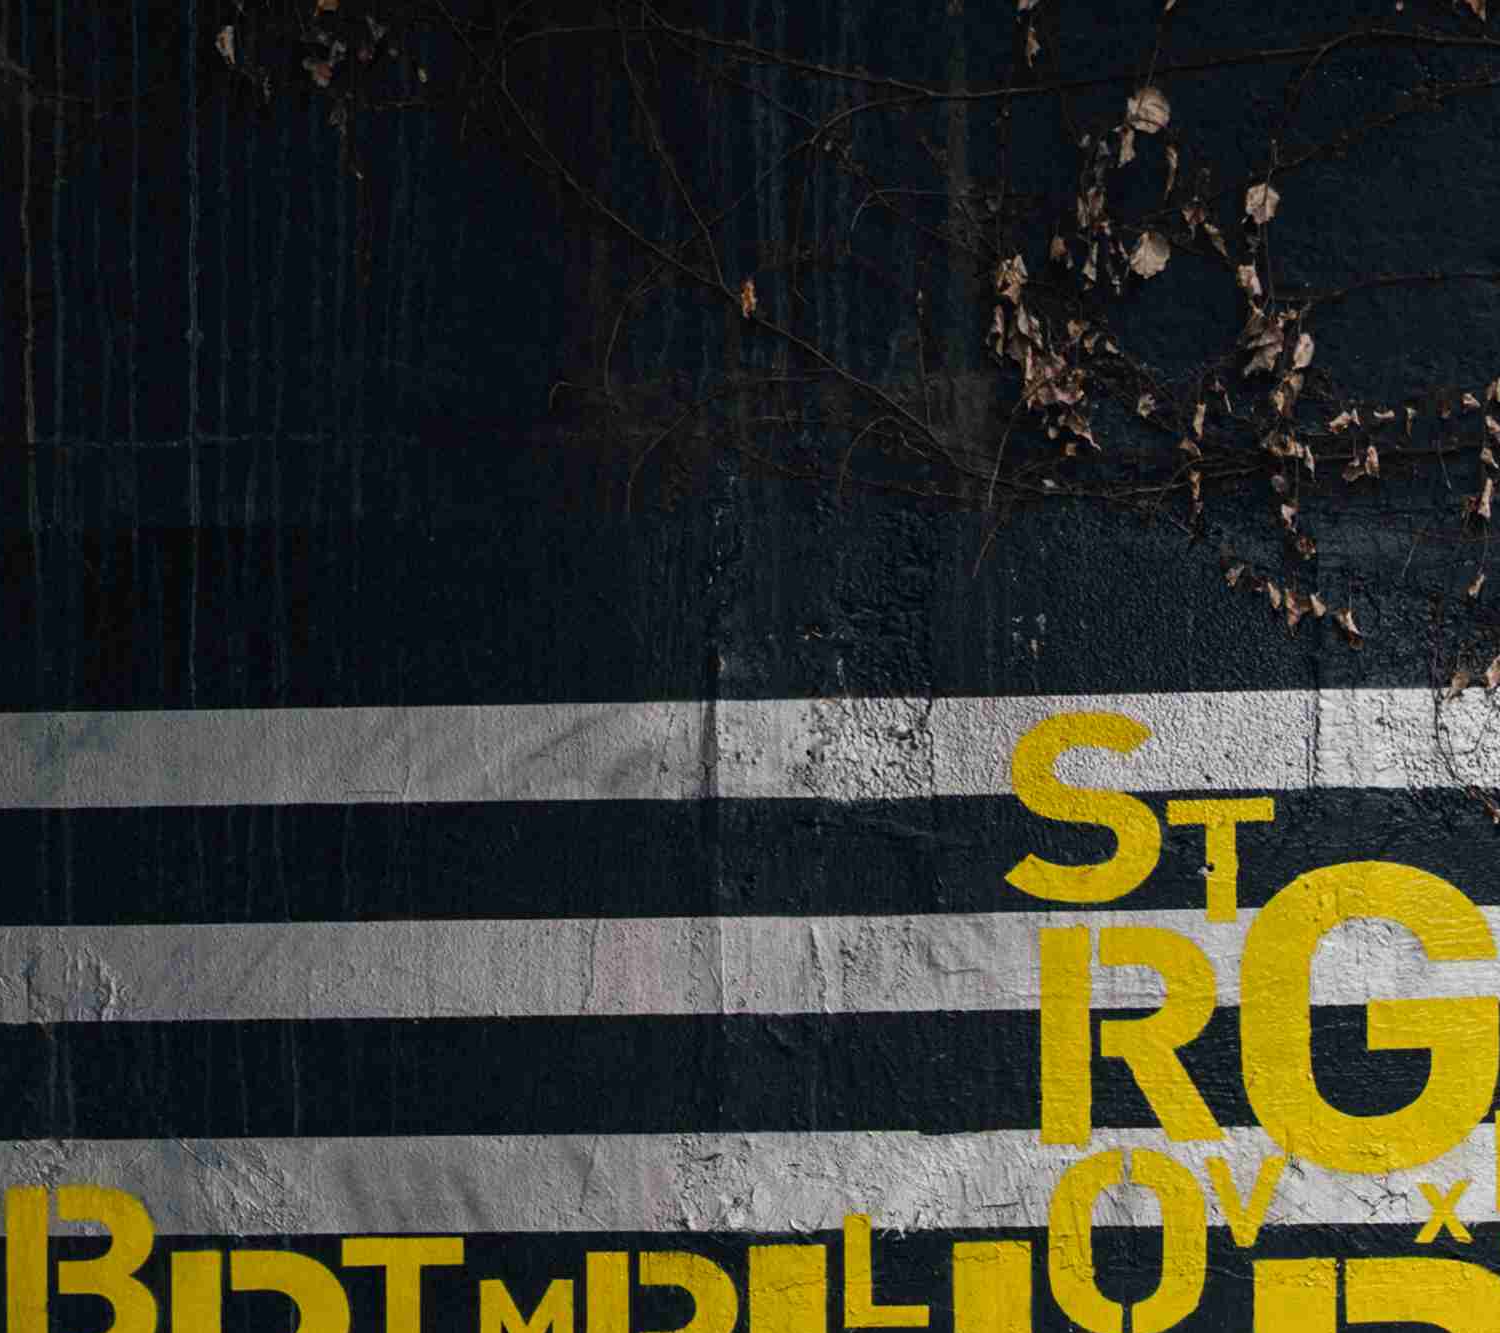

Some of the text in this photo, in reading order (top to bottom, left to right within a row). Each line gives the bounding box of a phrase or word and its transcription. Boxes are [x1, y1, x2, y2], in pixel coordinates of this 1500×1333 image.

[1007, 713, 1275, 921] S T
[1040, 861, 1500, 1173] R G
[843, 1214, 930, 1328] L
[1206, 1155, 1283, 1247] V
[1416, 1181, 1471, 1244] X
